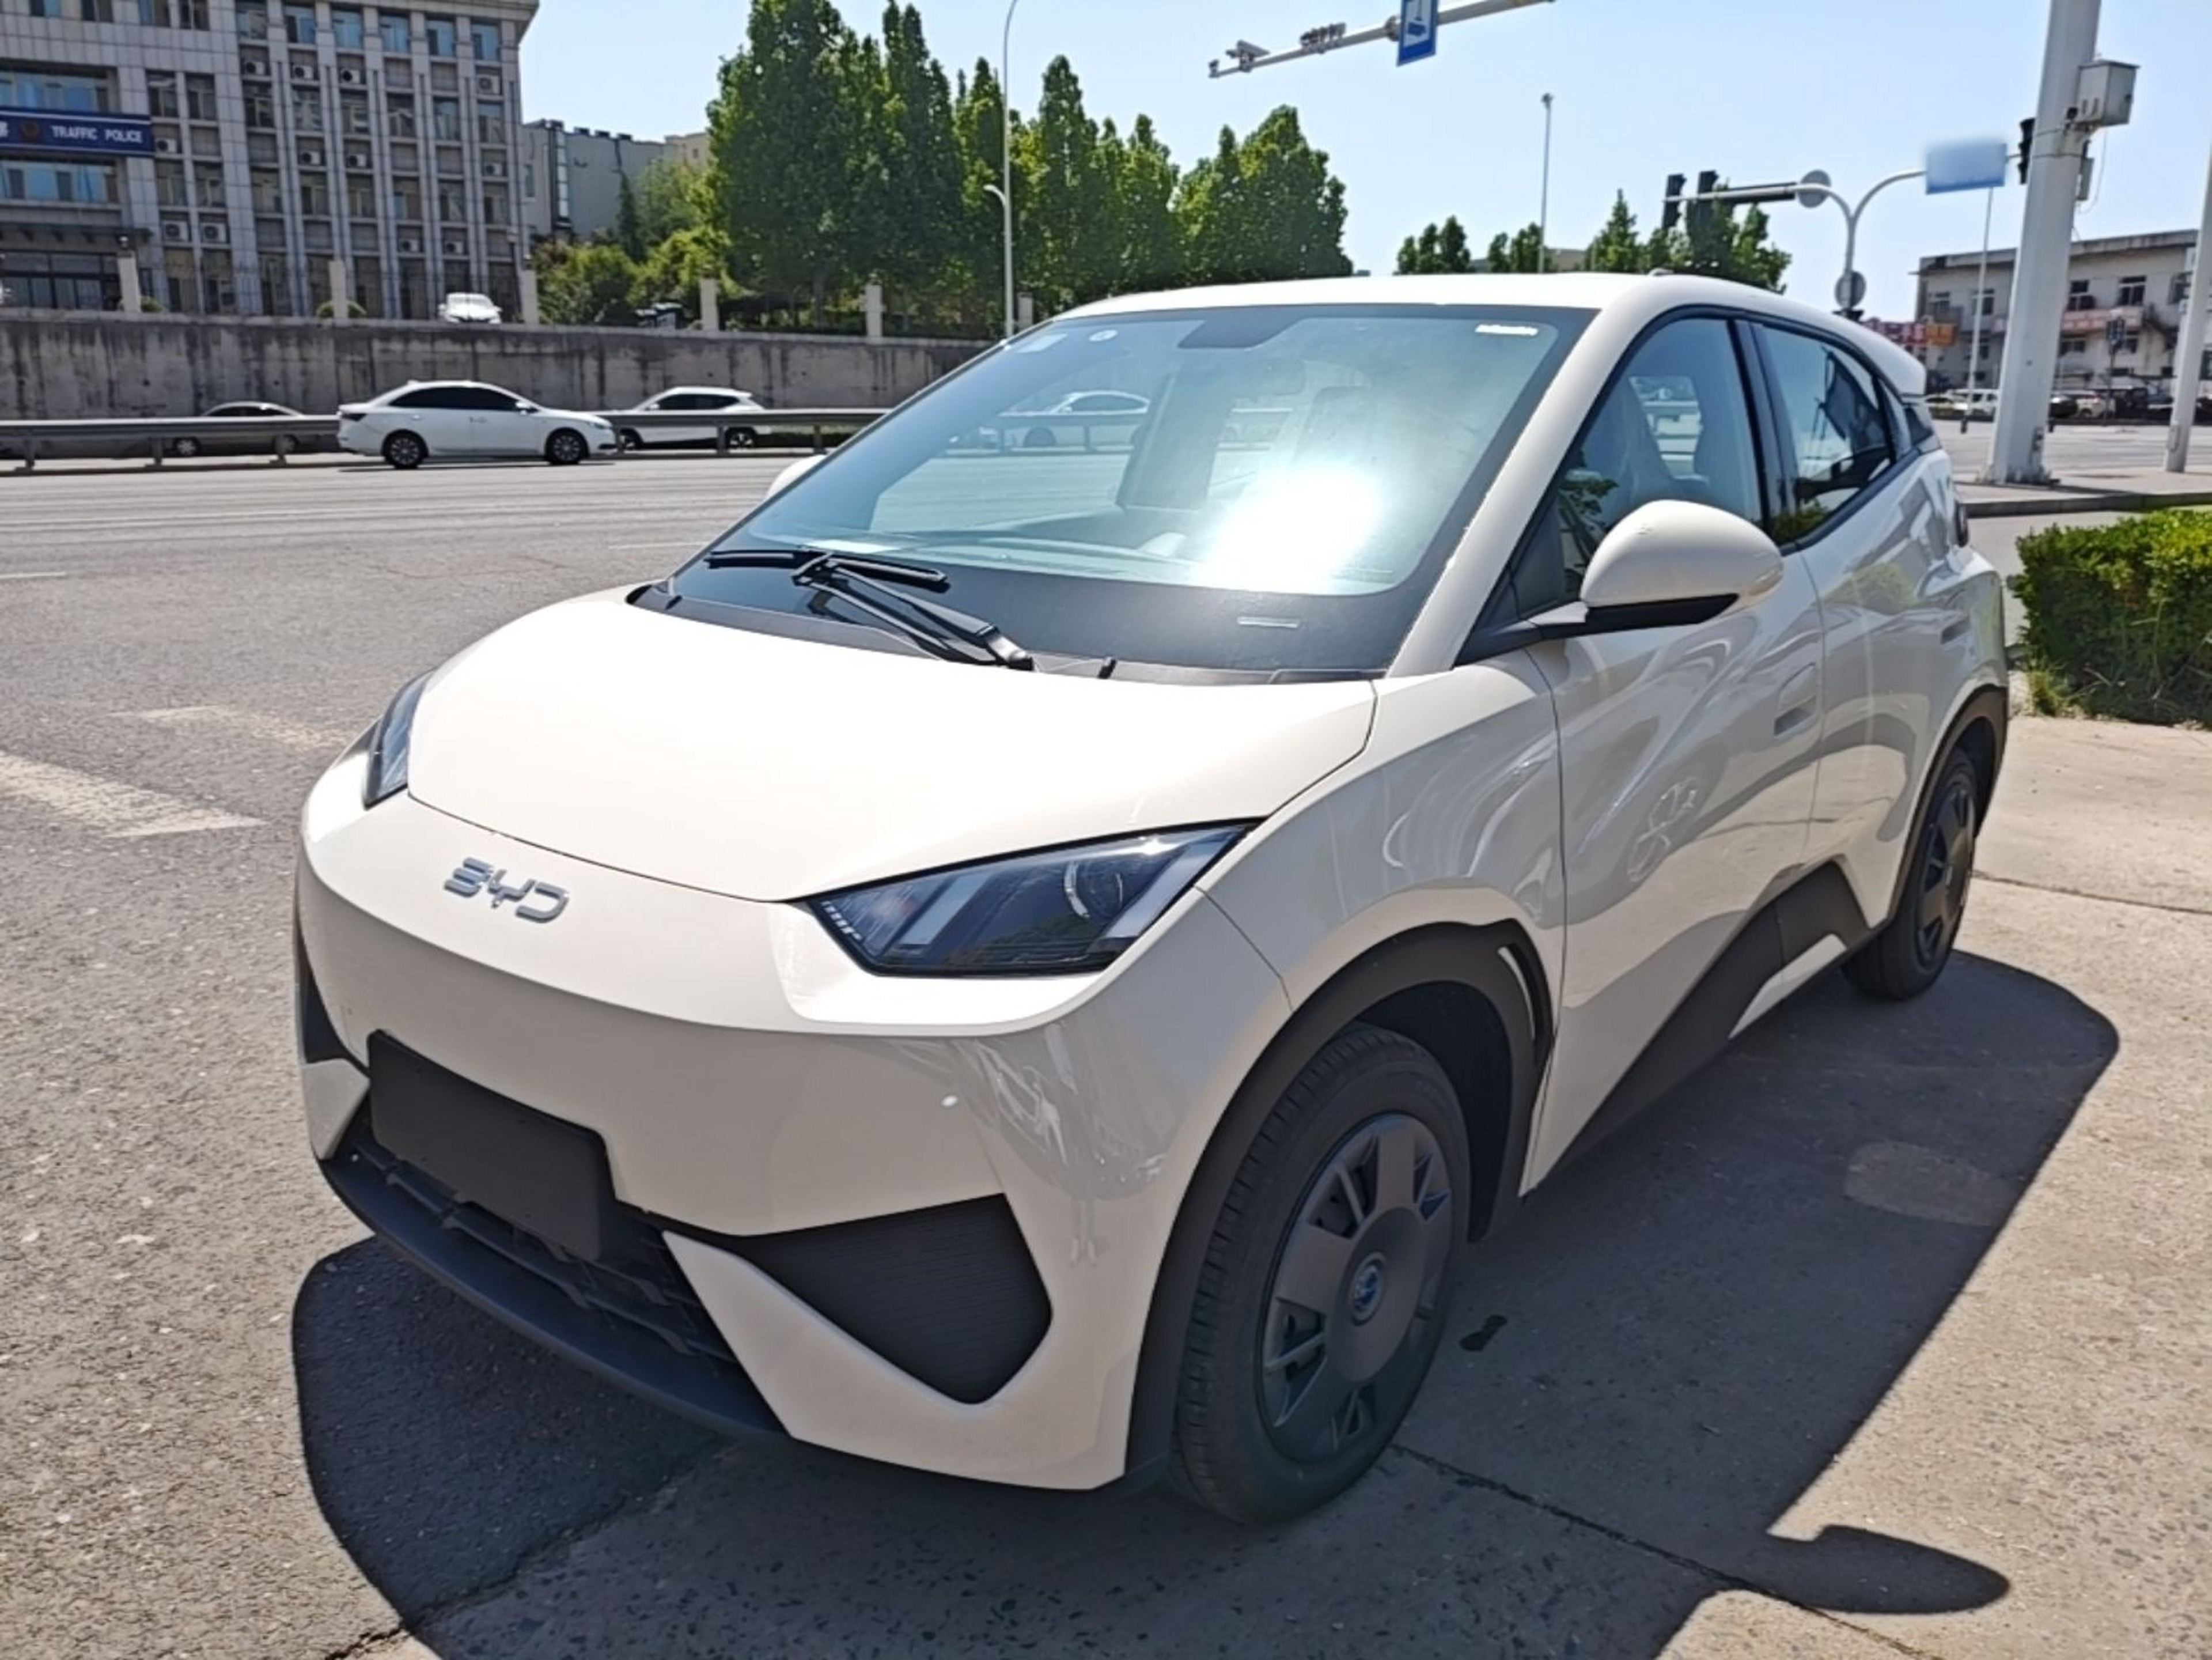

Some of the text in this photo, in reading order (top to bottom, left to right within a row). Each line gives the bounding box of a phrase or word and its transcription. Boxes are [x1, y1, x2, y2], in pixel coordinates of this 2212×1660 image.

[51, 124, 143, 143] TRAFFIC POLICE
[444, 857, 569, 924] BYD
